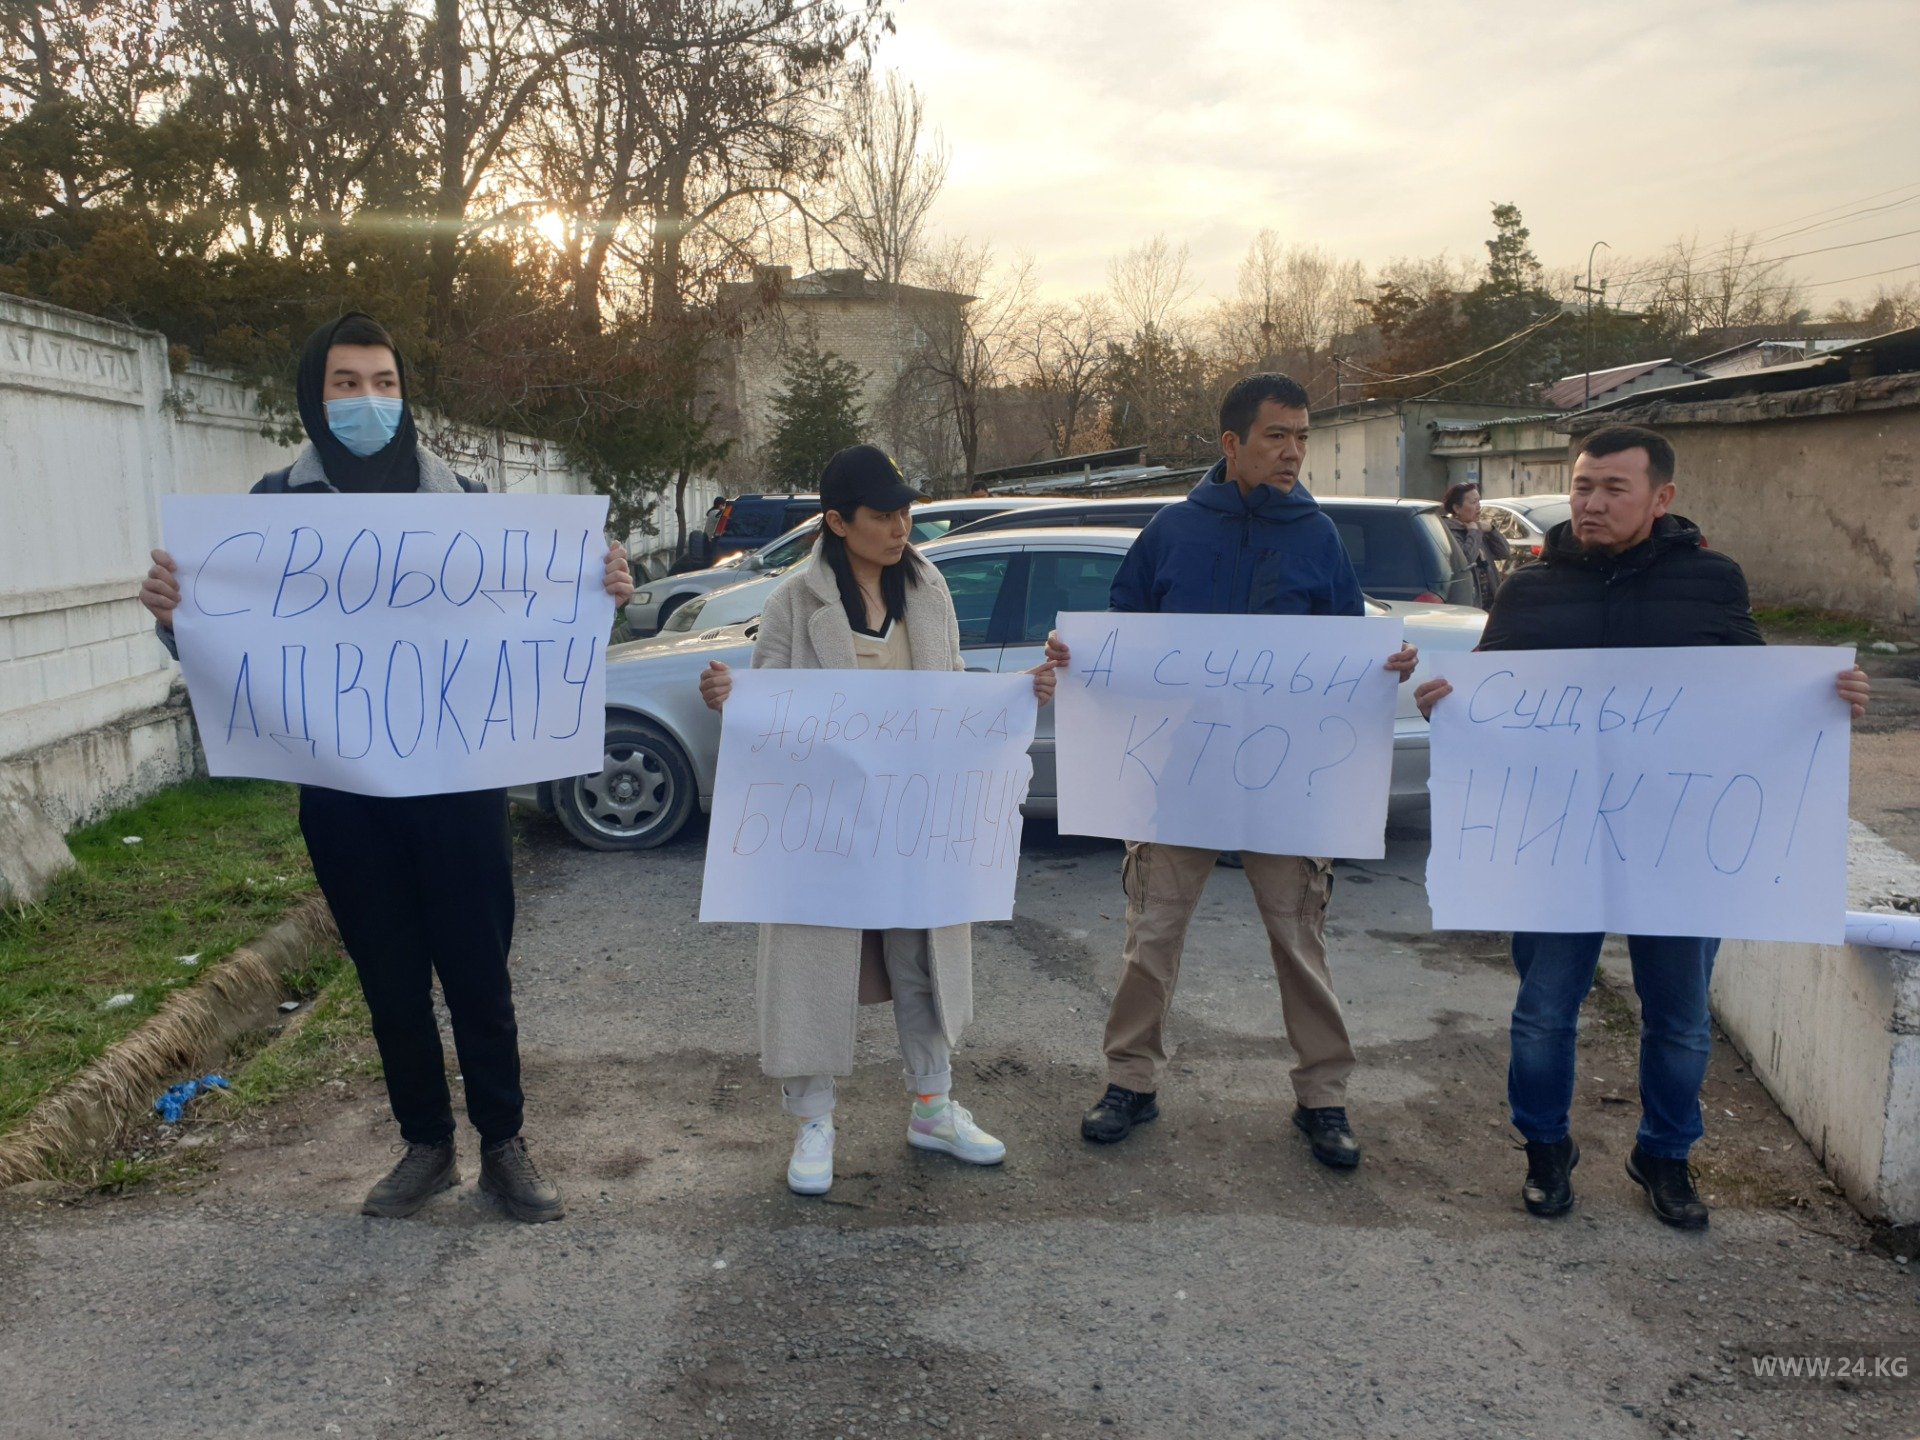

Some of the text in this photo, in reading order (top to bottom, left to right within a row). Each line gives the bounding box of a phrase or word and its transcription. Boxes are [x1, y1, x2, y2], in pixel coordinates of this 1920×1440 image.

[193, 525, 589, 624] СВОБОДУ
[224, 636, 597, 760] АДВОКАТУ
[1081, 628, 1374, 703] А СУДЬИ
[1118, 715, 1358, 797] КТО?
[732, 769, 1031, 870] БОШТОНДУК
[1459, 731, 1823, 884] НИКТО!
